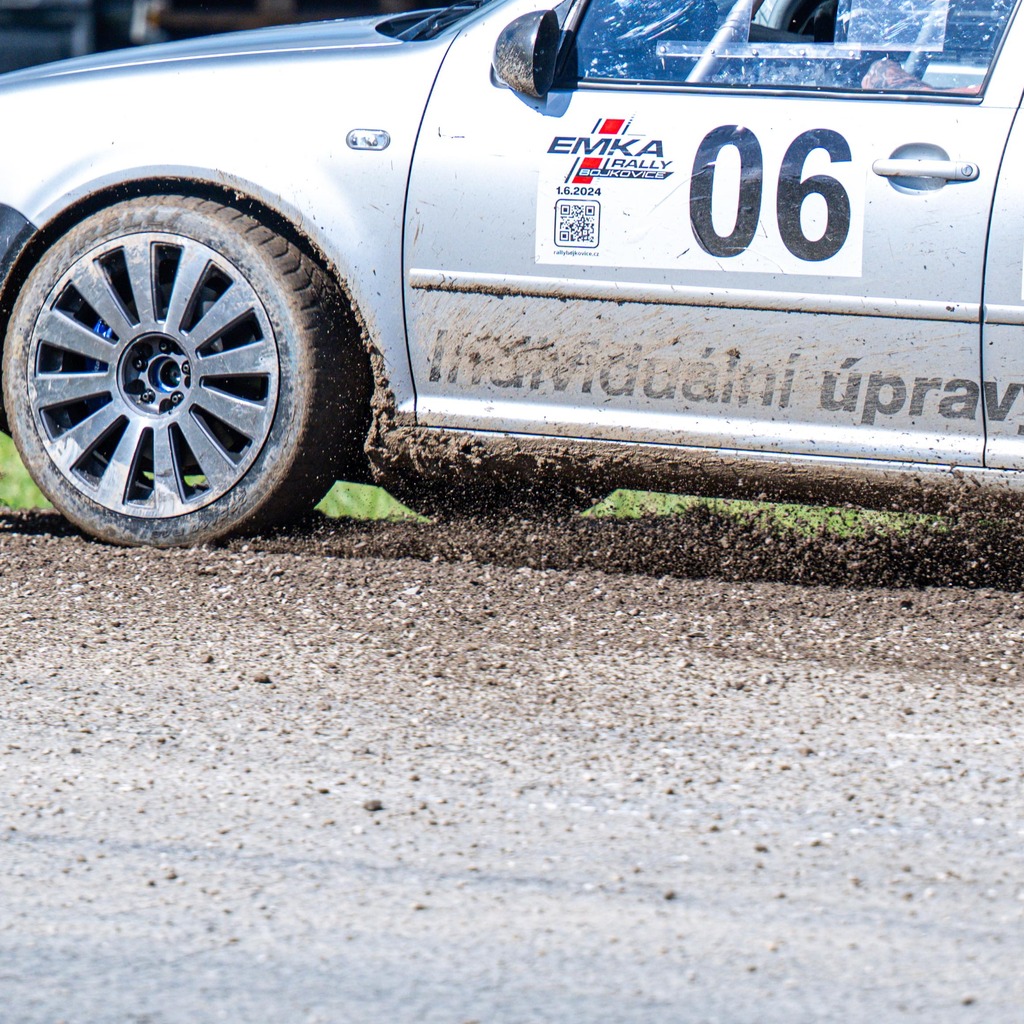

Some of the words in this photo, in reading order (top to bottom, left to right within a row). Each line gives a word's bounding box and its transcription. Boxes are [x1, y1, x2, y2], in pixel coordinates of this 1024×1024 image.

[547, 136, 664, 158] EMKA
[611, 158, 673, 170] RALLY
[578, 168, 666, 179] BOJKOVICE
[556, 186, 601, 196] 1.6.2024
[689, 124, 853, 262] 06
